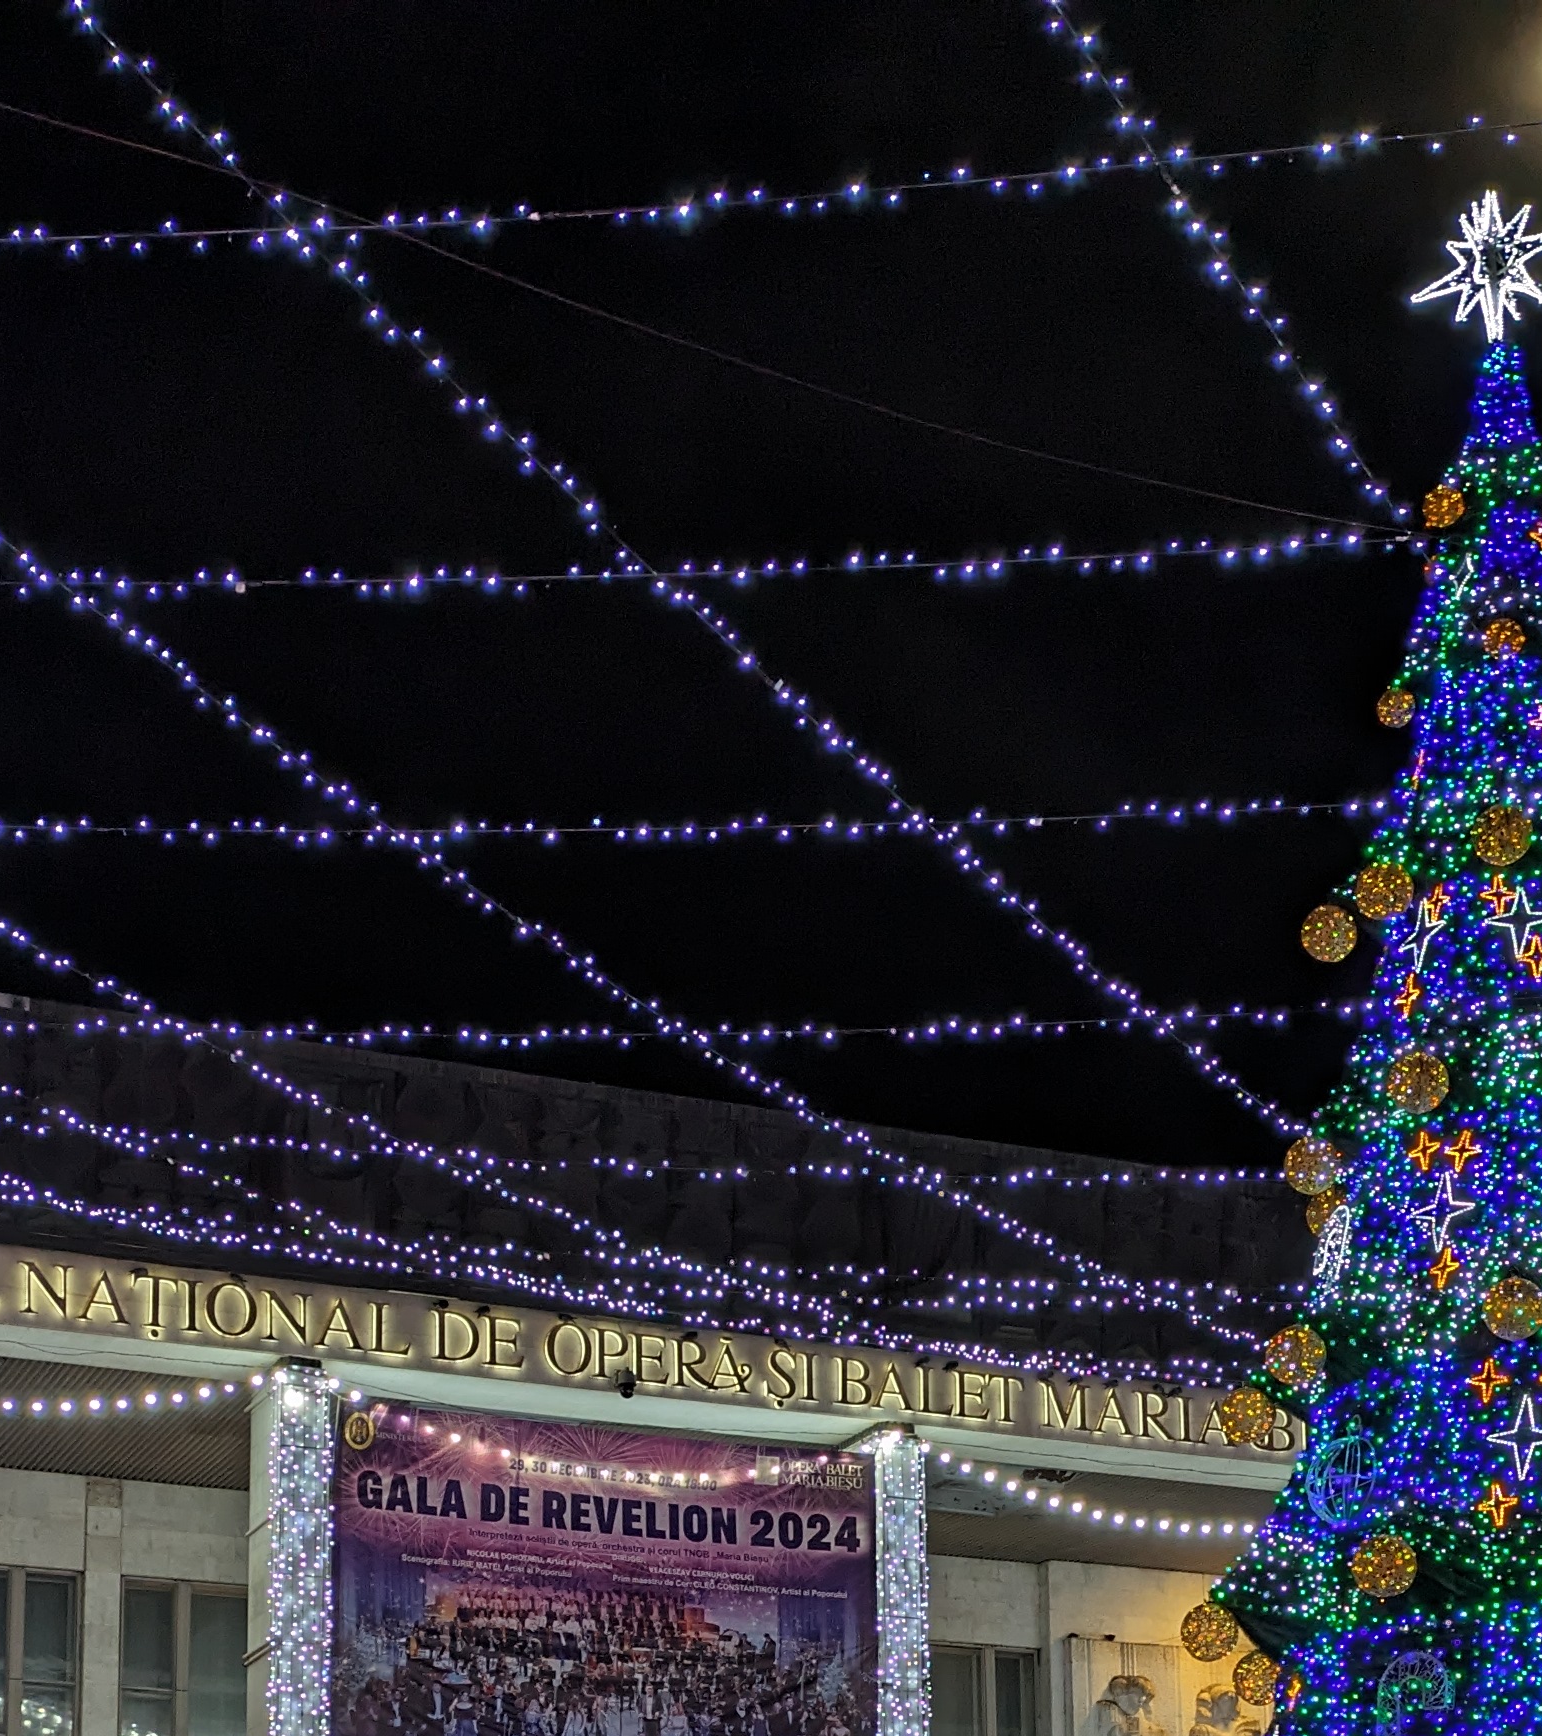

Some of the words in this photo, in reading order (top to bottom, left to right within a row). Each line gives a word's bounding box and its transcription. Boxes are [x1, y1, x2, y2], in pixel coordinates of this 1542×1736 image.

[18, 1261, 412, 1358] NAȚIONAL
[432, 1306, 525, 1369] DE
[544, 1321, 752, 1393] OPERĂ
[764, 1349, 822, 1410] ȘI
[835, 1357, 1024, 1424] BALET
[1038, 1381, 1237, 1446] MARIA
[509, 1458, 528, 1473] 29,
[532, 1458, 547, 1474] 30
[826, 1462, 864, 1477] BALET
[781, 1474, 824, 1487] MARIA
[356, 1470, 467, 1520] GALA
[480, 1483, 530, 1526] DE
[542, 1489, 738, 1545] REVELION
[749, 1509, 861, 1553] 2024
